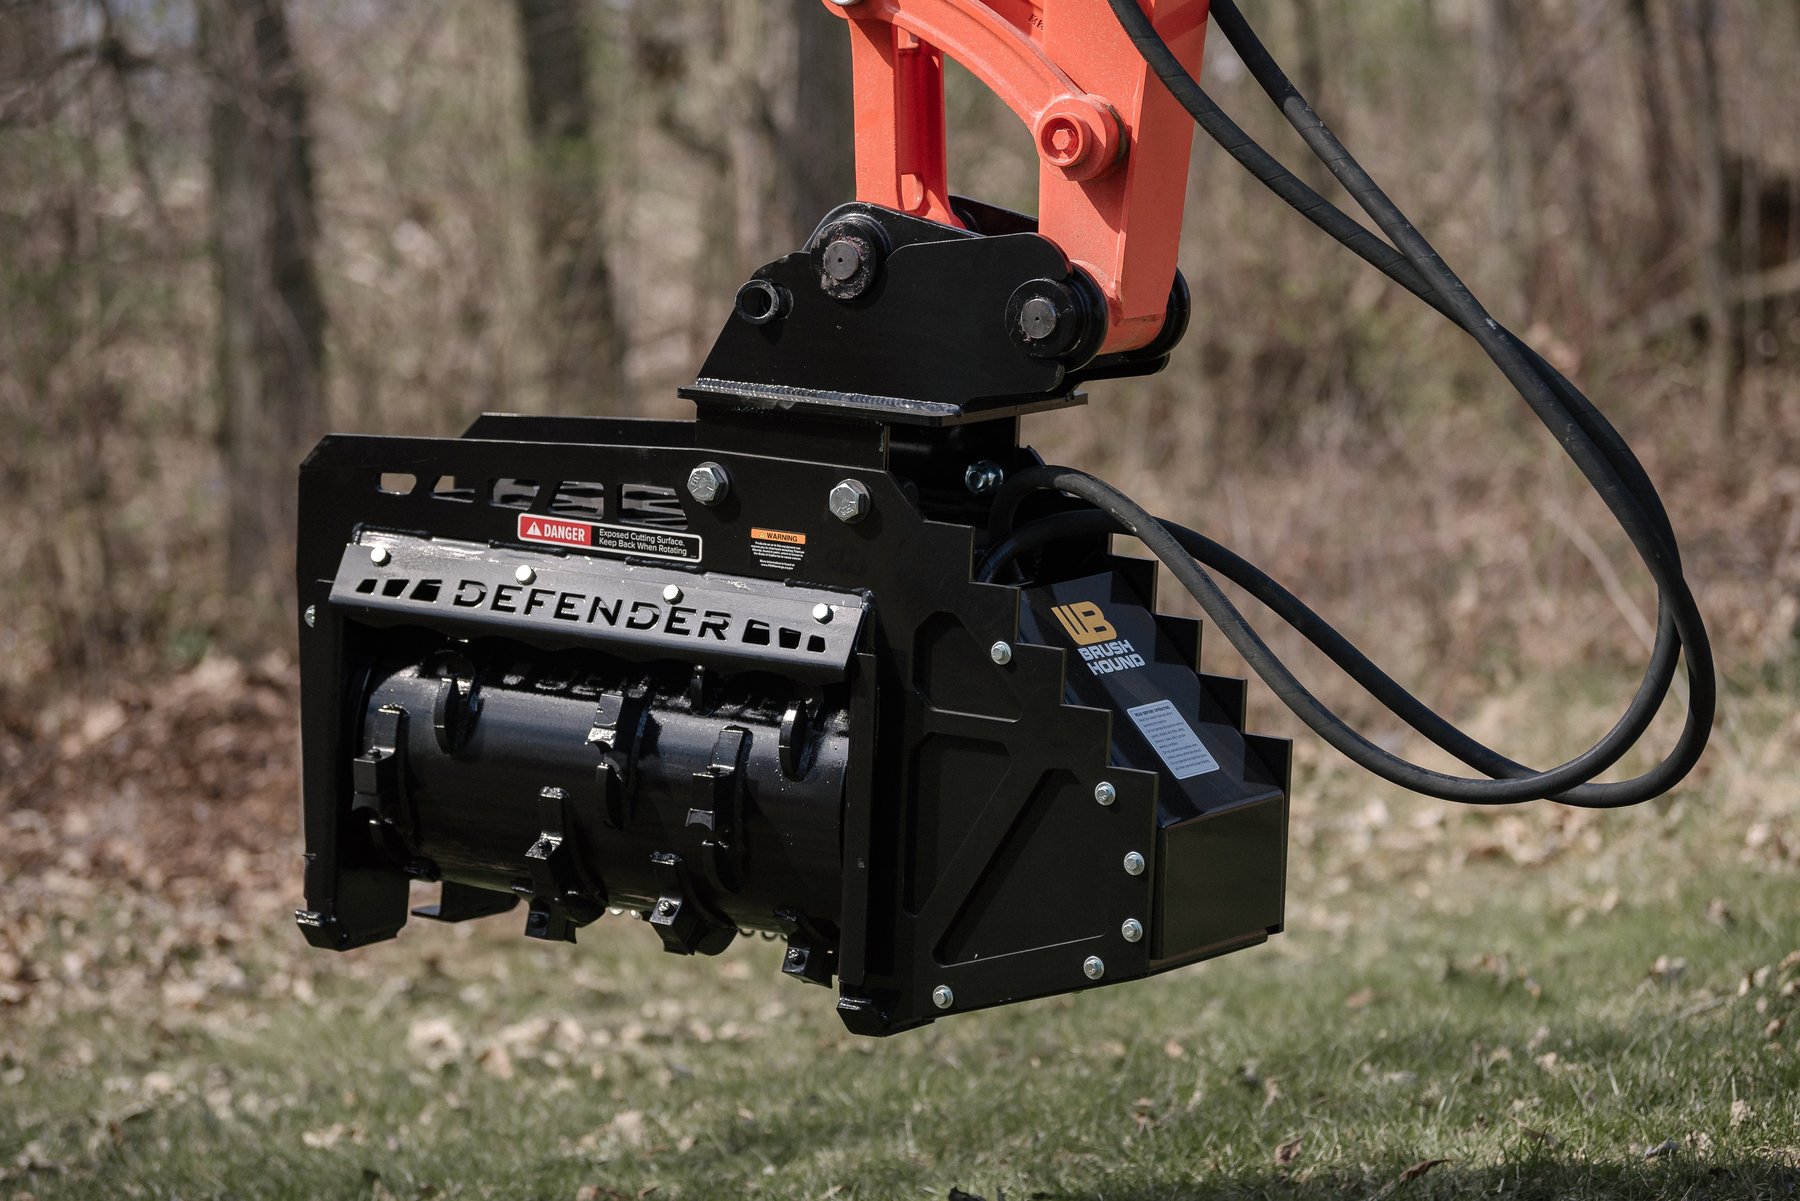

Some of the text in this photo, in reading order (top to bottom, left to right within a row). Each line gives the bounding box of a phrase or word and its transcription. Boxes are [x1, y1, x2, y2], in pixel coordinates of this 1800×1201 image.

[544, 524, 585, 542] DANGER
[599, 529, 685, 546] Exposed Cutting Surface.
[767, 532, 797, 542] WARNING
[599, 538, 687, 556] Keep Back When Rotating
[453, 579, 733, 641] DEFENDER
[1077, 640, 1135, 661] BRUSH
[1087, 654, 1145, 675] HOUND
